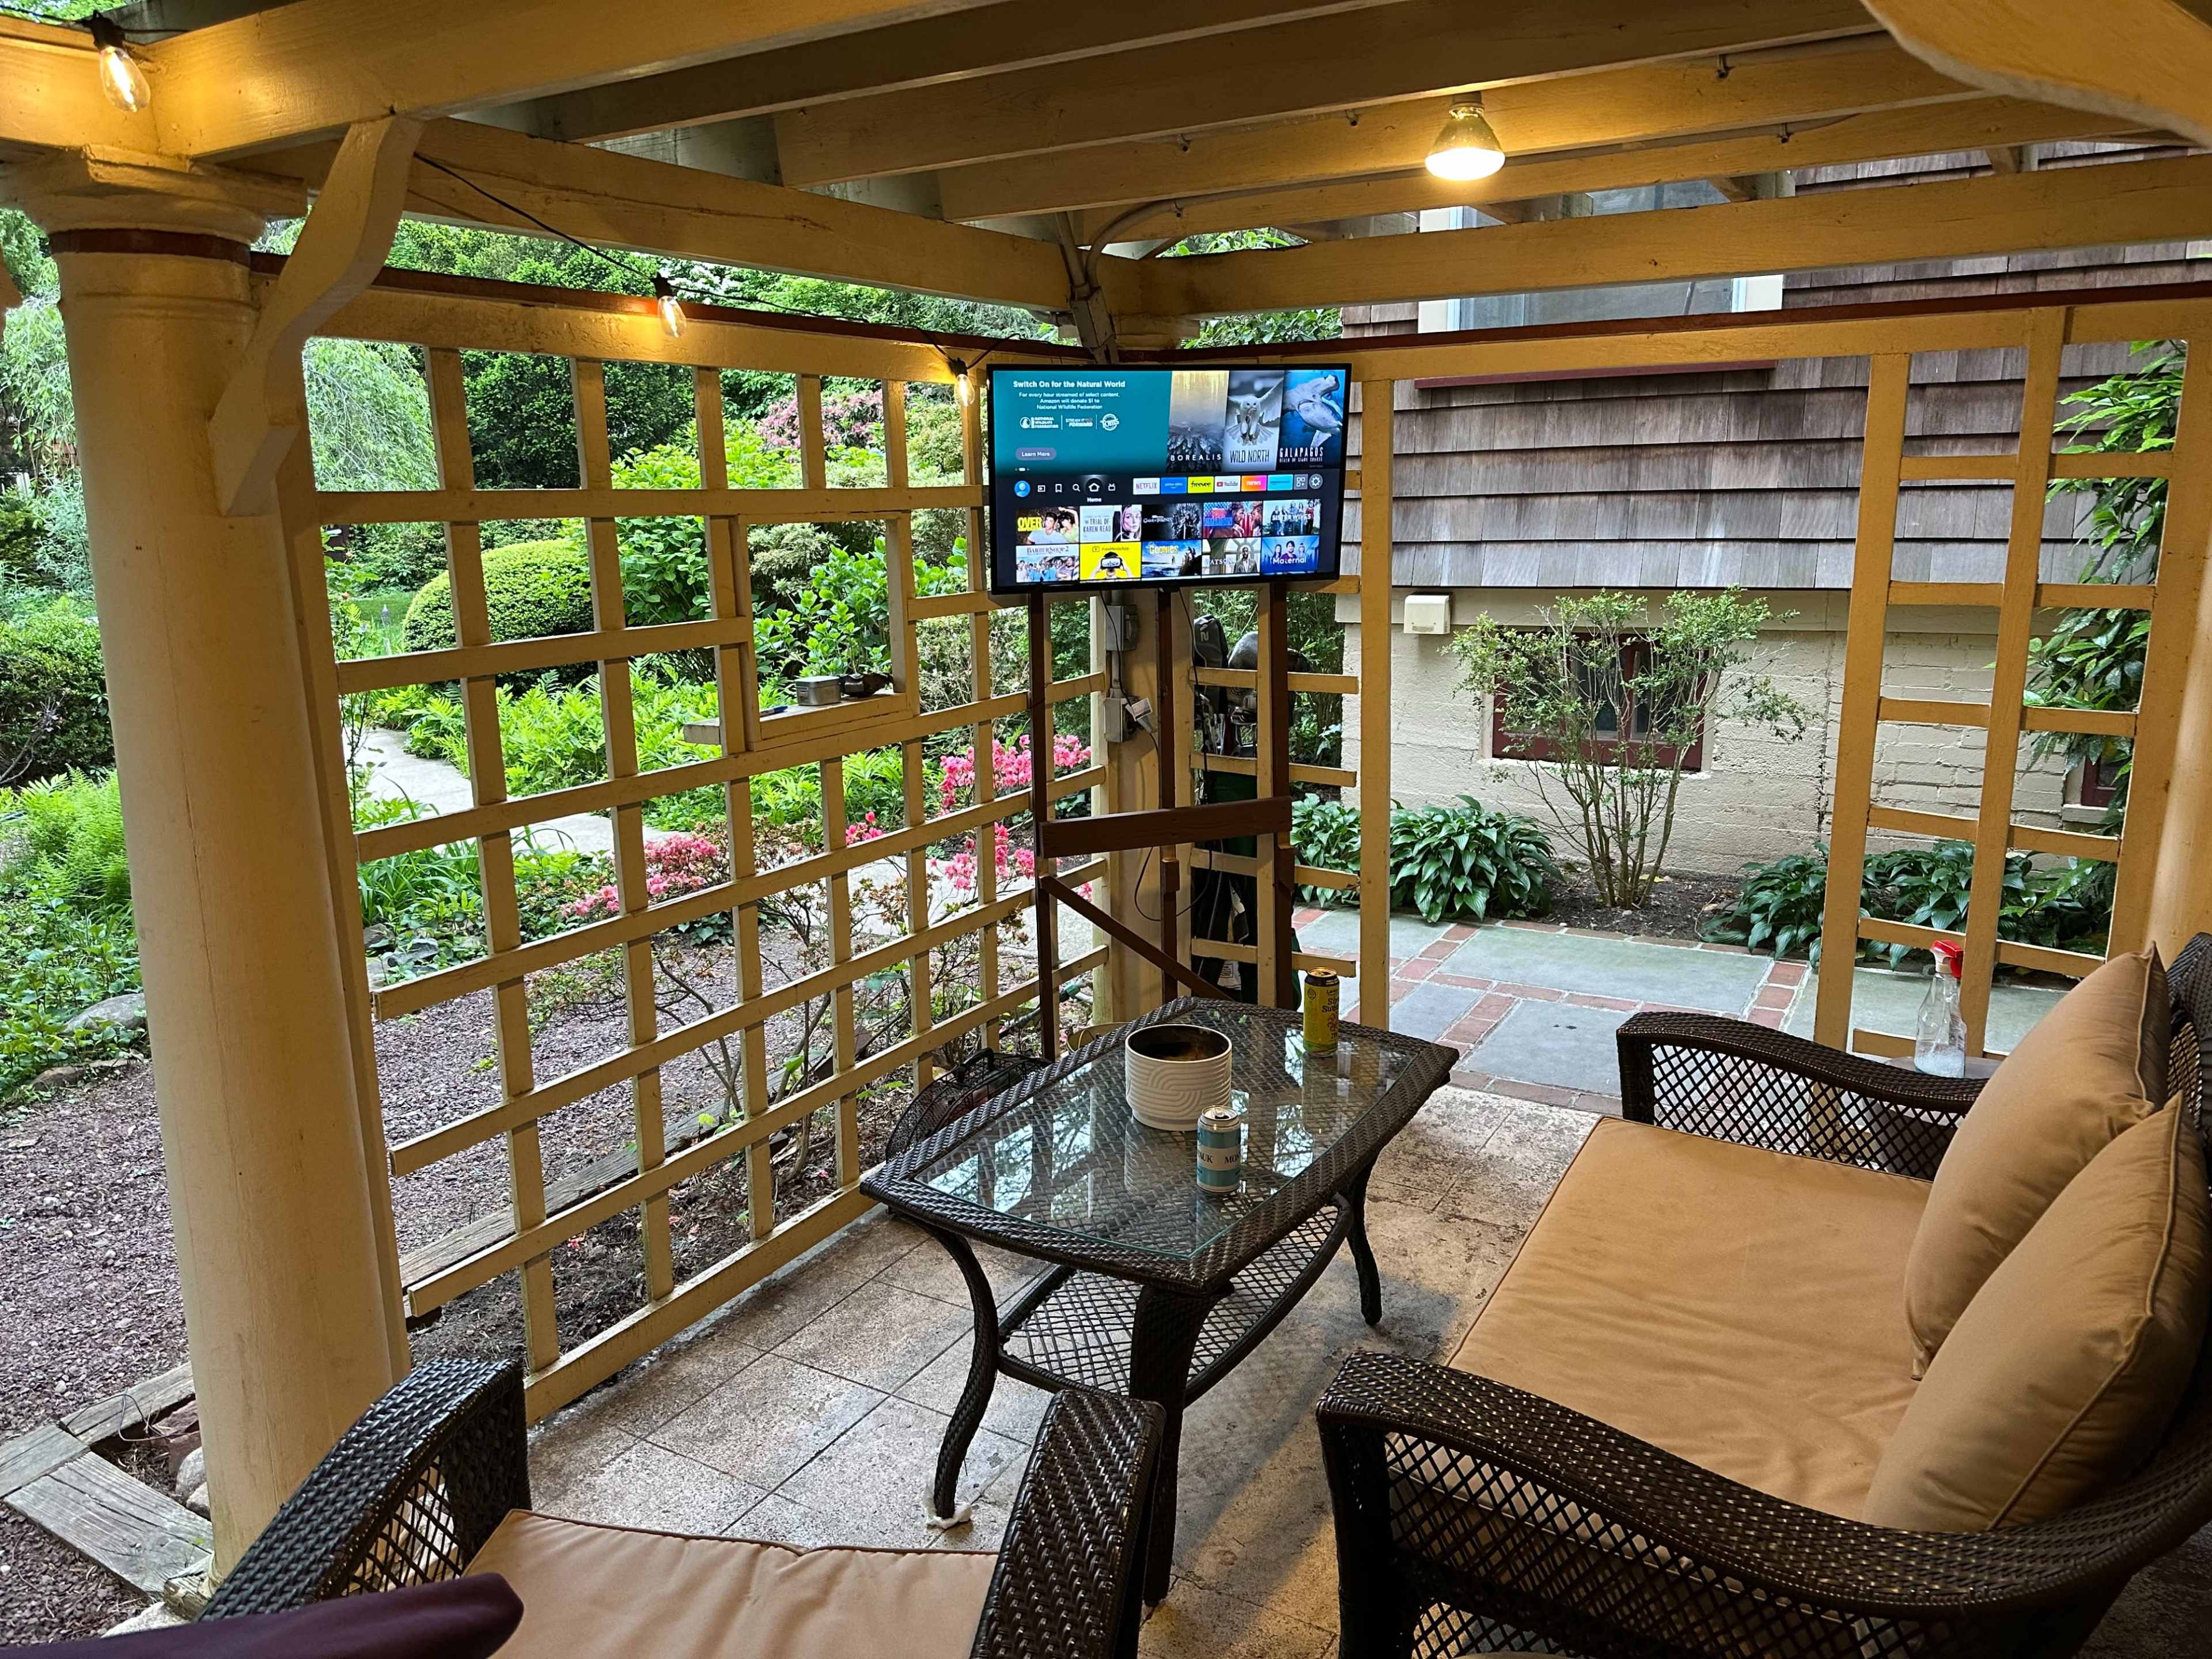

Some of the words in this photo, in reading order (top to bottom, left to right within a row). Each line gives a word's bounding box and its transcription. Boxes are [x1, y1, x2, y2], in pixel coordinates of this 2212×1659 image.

[1279, 446, 1323, 457] GALAPAGOS
[1170, 453, 1222, 461] BOREALIS
[1230, 450, 1246, 463] WILD
[1248, 449, 1270, 463] NORTH
[1135, 482, 1157, 490] NETFLIX
[1191, 480, 1212, 488] freevee
[1272, 556, 1306, 565] Maternal
